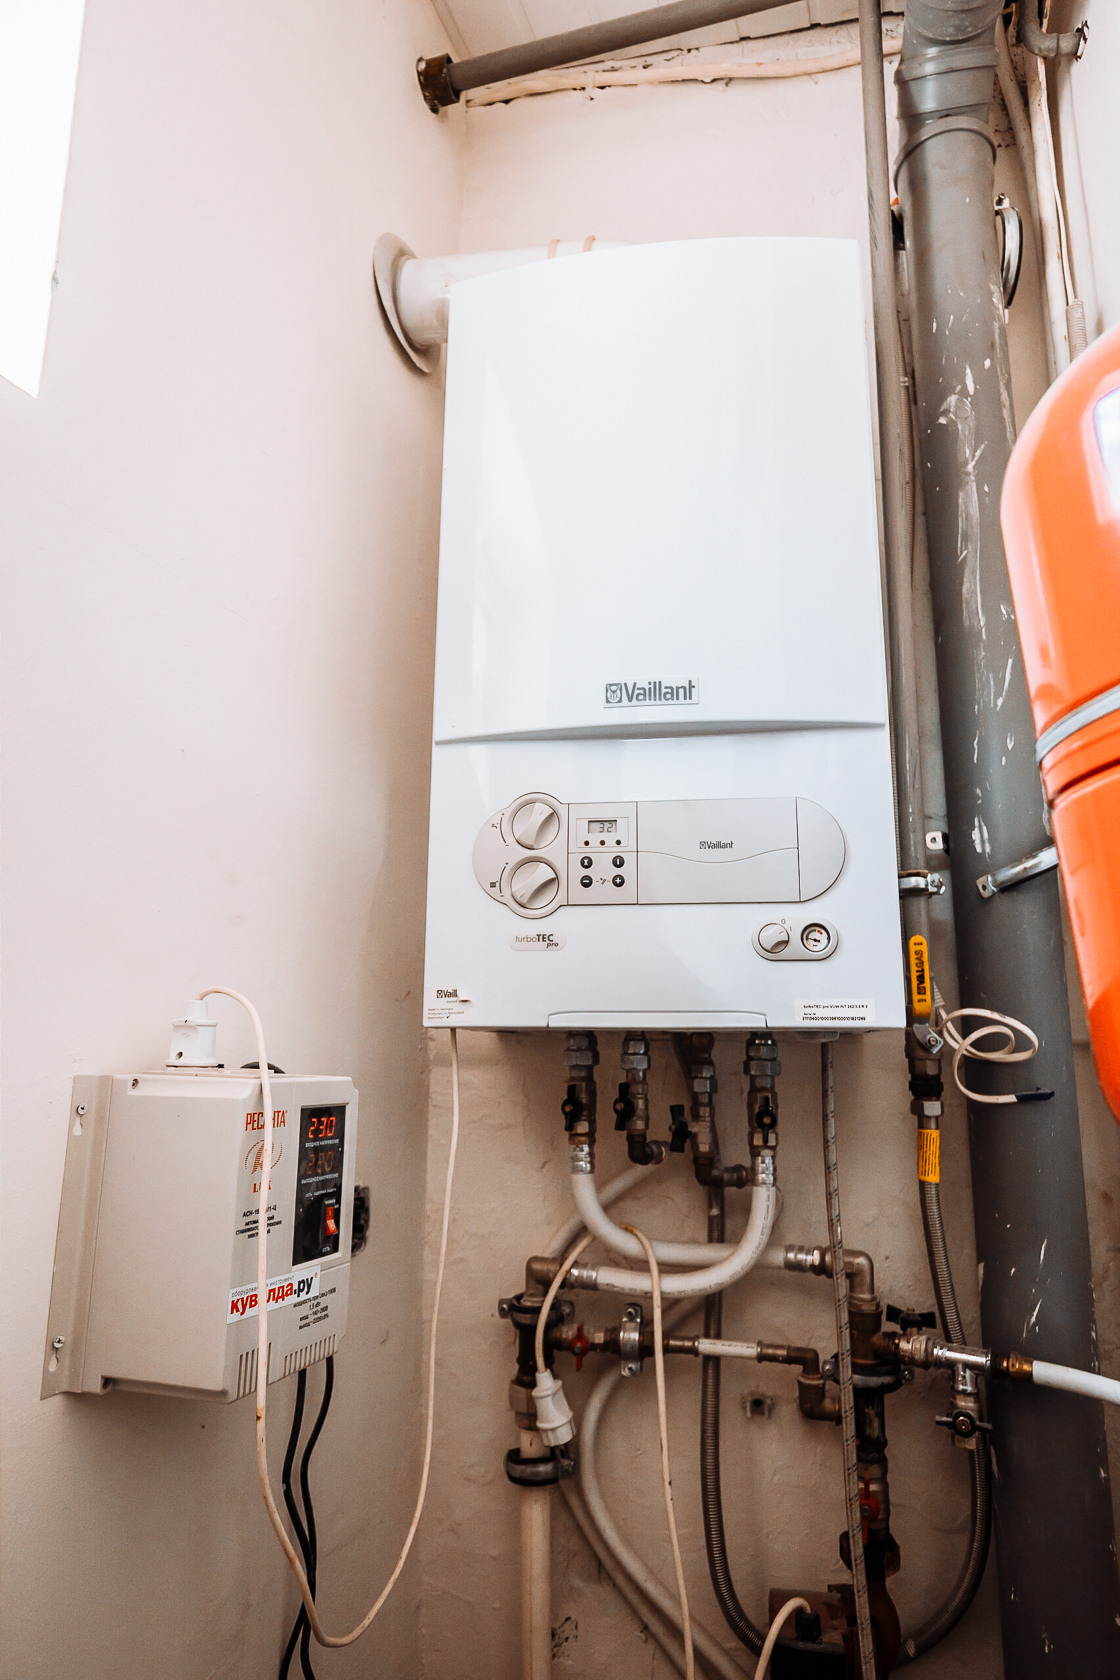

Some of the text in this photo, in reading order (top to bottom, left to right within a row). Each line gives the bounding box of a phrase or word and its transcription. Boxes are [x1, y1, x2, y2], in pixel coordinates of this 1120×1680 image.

[624, 680, 696, 703] Vaillant
[706, 840, 734, 850] Vaillant
[515, 934, 554, 944] turboTEC
[546, 940, 559, 949] pro
[914, 949, 926, 987] VALGAS
[308, 1116, 336, 1139] 230
[230, 1276, 314, 1316] кувлда.ру
